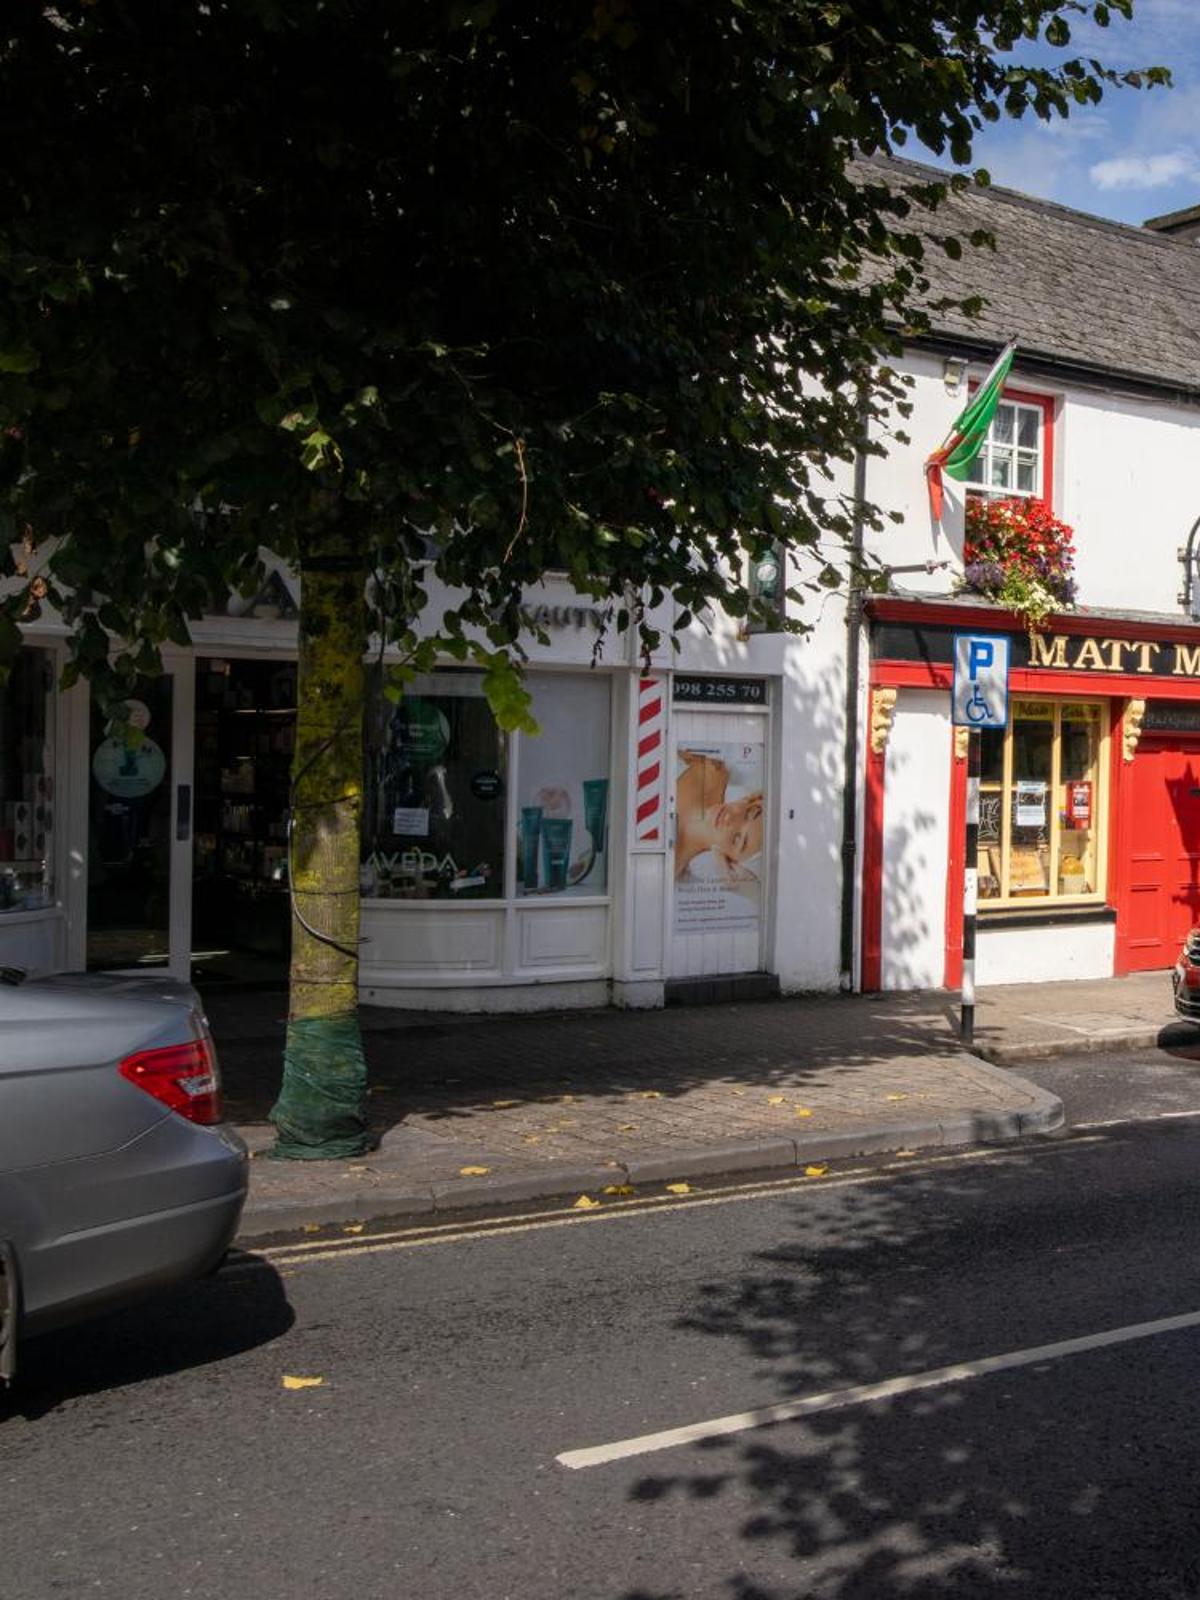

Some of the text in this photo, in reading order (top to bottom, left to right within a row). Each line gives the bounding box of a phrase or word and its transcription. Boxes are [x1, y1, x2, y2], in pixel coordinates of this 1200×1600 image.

[969, 641, 993, 681] P
[1028, 633, 1160, 673] MATT
[706, 683, 736, 697] 255
[741, 686, 760, 698] 70
[365, 851, 459, 872] AVEDA
